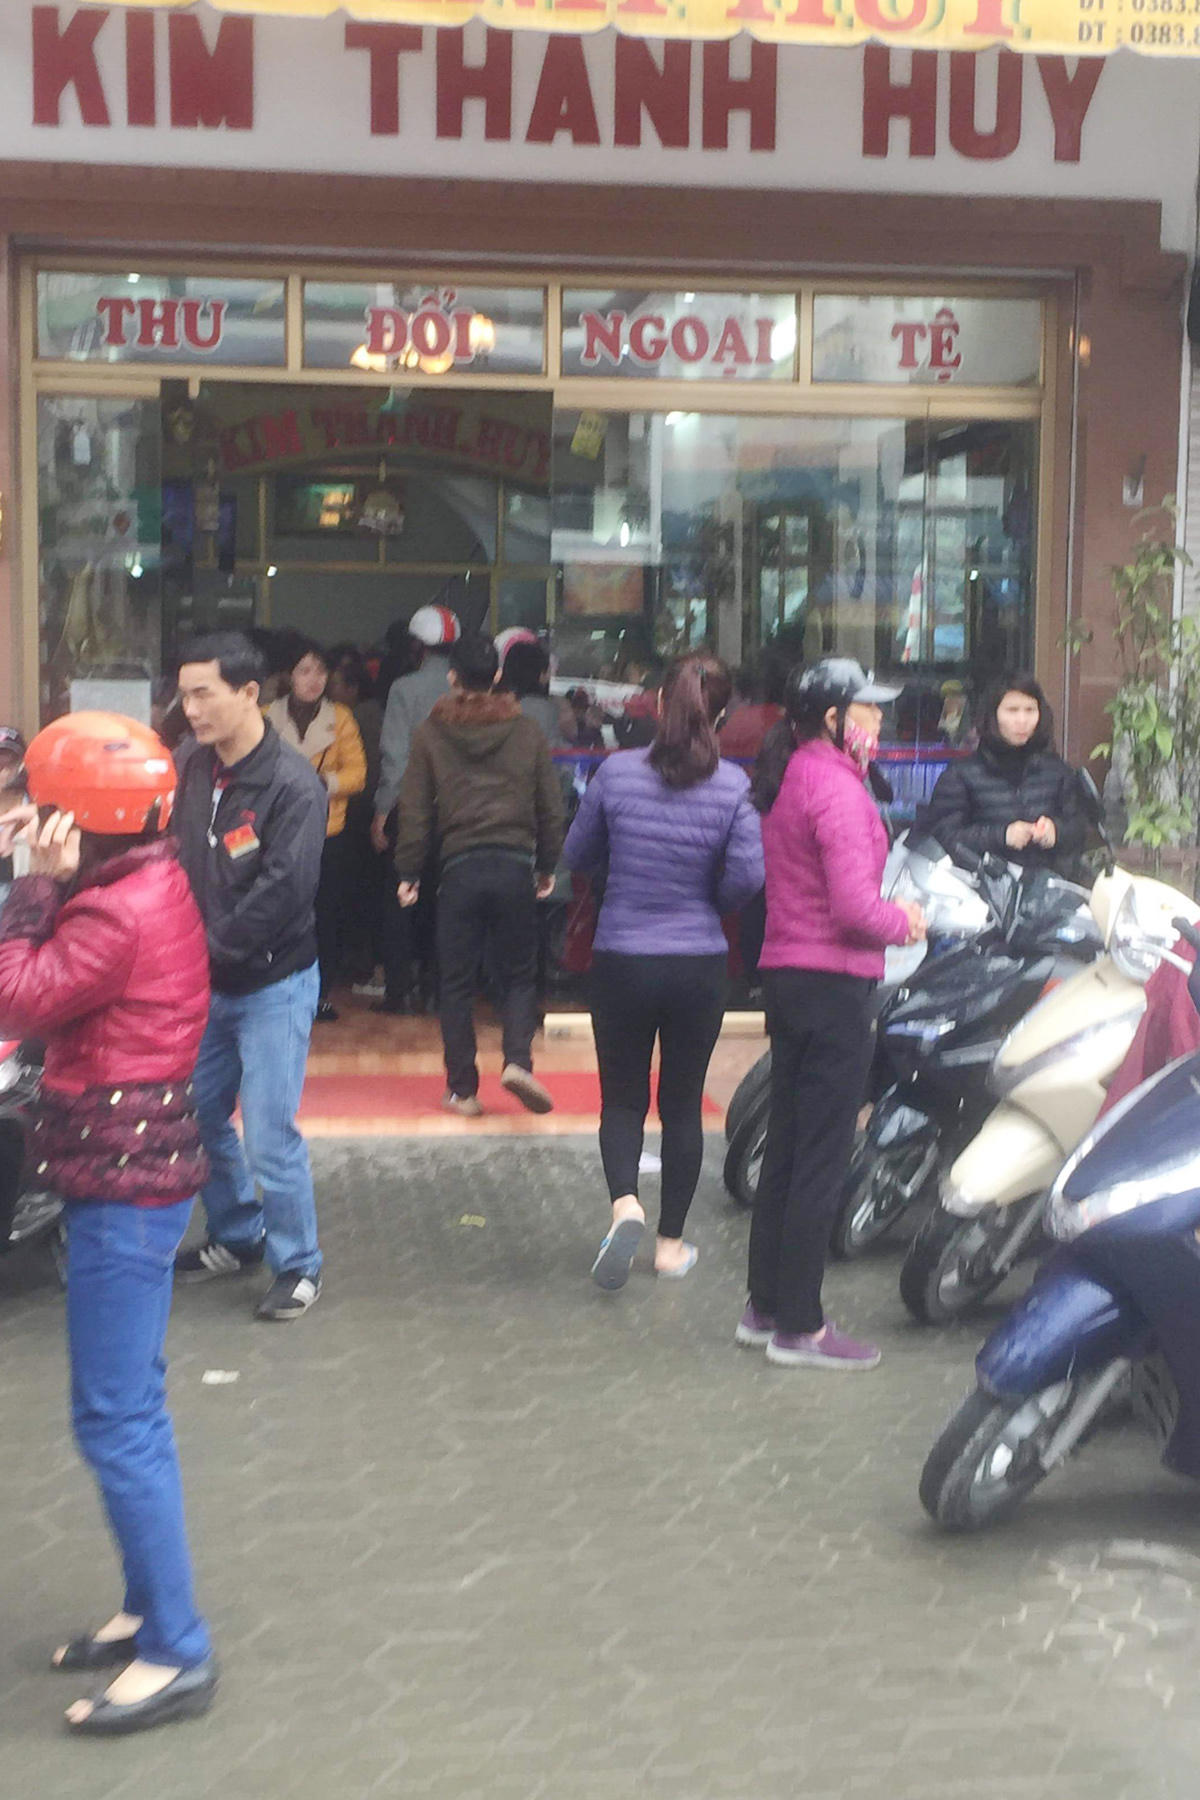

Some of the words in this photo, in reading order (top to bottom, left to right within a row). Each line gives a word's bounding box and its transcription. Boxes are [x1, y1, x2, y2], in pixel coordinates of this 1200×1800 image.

[32, 6, 254, 130] KIM
[345, 22, 778, 152] THANH
[862, 43, 1106, 163] HUY
[97, 297, 226, 350] THU
[366, 288, 476, 360] ĐỔI
[579, 312, 776, 378] NGOẠI
[890, 307, 963, 384] TỆ
[220, 408, 302, 473] KIM
